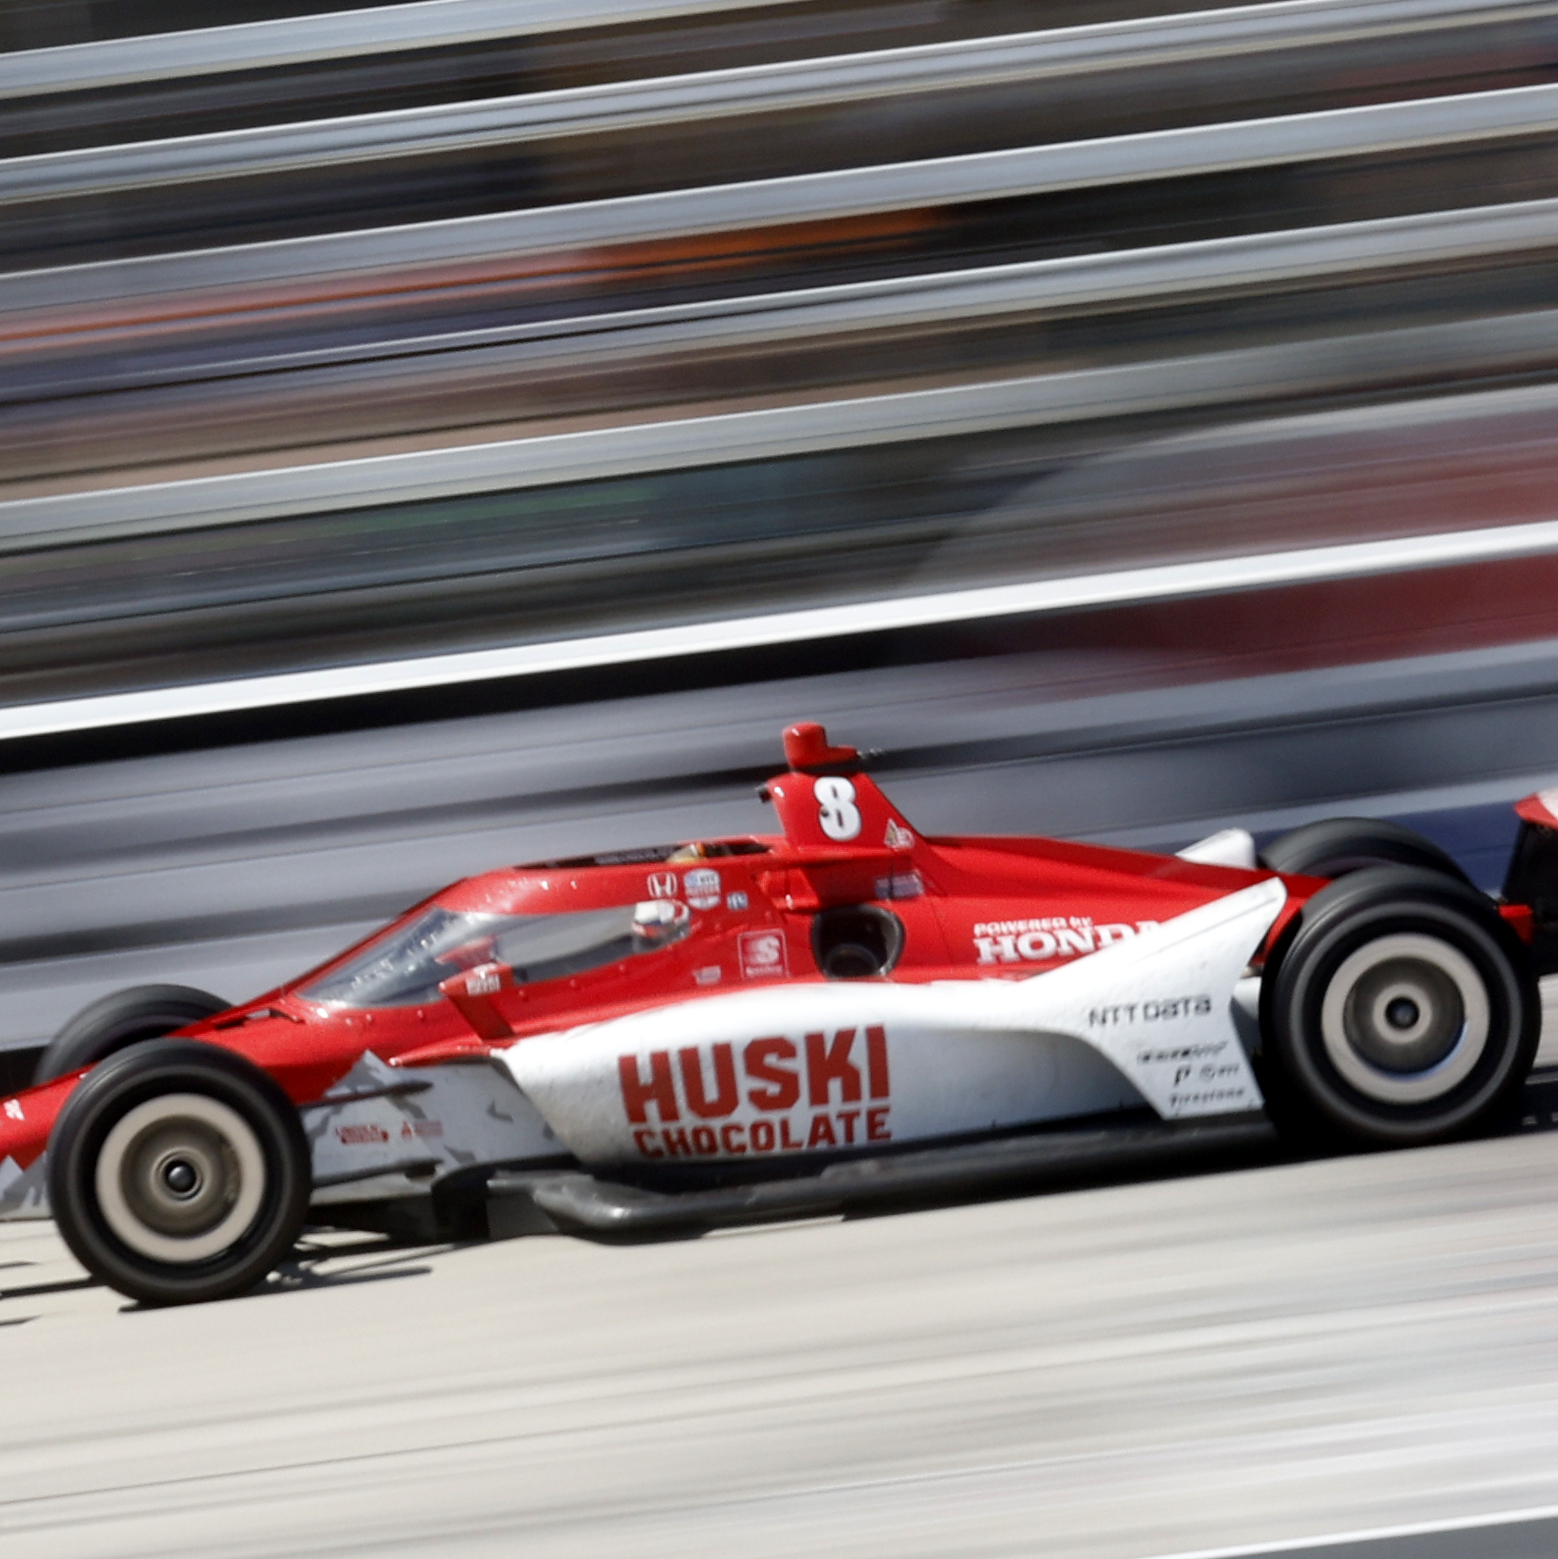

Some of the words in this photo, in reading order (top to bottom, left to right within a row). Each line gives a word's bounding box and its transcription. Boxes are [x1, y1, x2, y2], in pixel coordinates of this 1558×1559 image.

[814, 776, 861, 841] 8
[973, 917, 1067, 936] POWERED
[1089, 1003, 1140, 1027] NTT
[619, 1023, 890, 1125] HUSKI
[633, 1104, 892, 1158] CHOCOLATE
